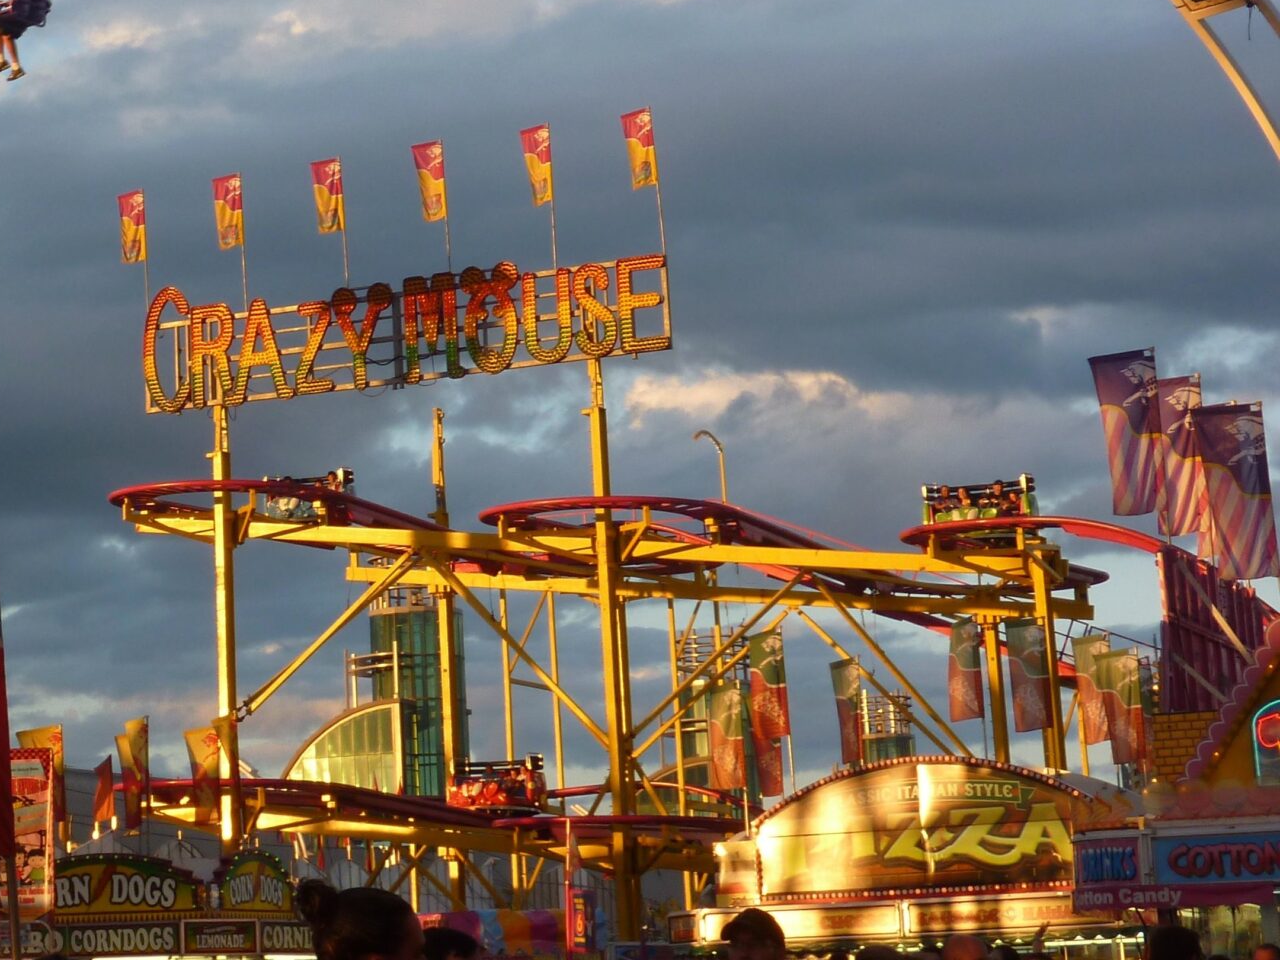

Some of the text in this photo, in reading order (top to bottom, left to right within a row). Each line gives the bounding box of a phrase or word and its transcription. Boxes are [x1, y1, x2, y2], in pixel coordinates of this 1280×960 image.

[143, 254, 673, 414] CRAZY MOUSE
[897, 783, 960, 800] ITAAN
[964, 781, 1014, 798] STYLE
[55, 873, 177, 908] RN DOGS
[230, 874, 284, 906] CORN DOGS
[1119, 887, 1182, 906] Candy
[70, 927, 175, 953] CORNDOGS
[196, 933, 245, 949] LEMONADE
